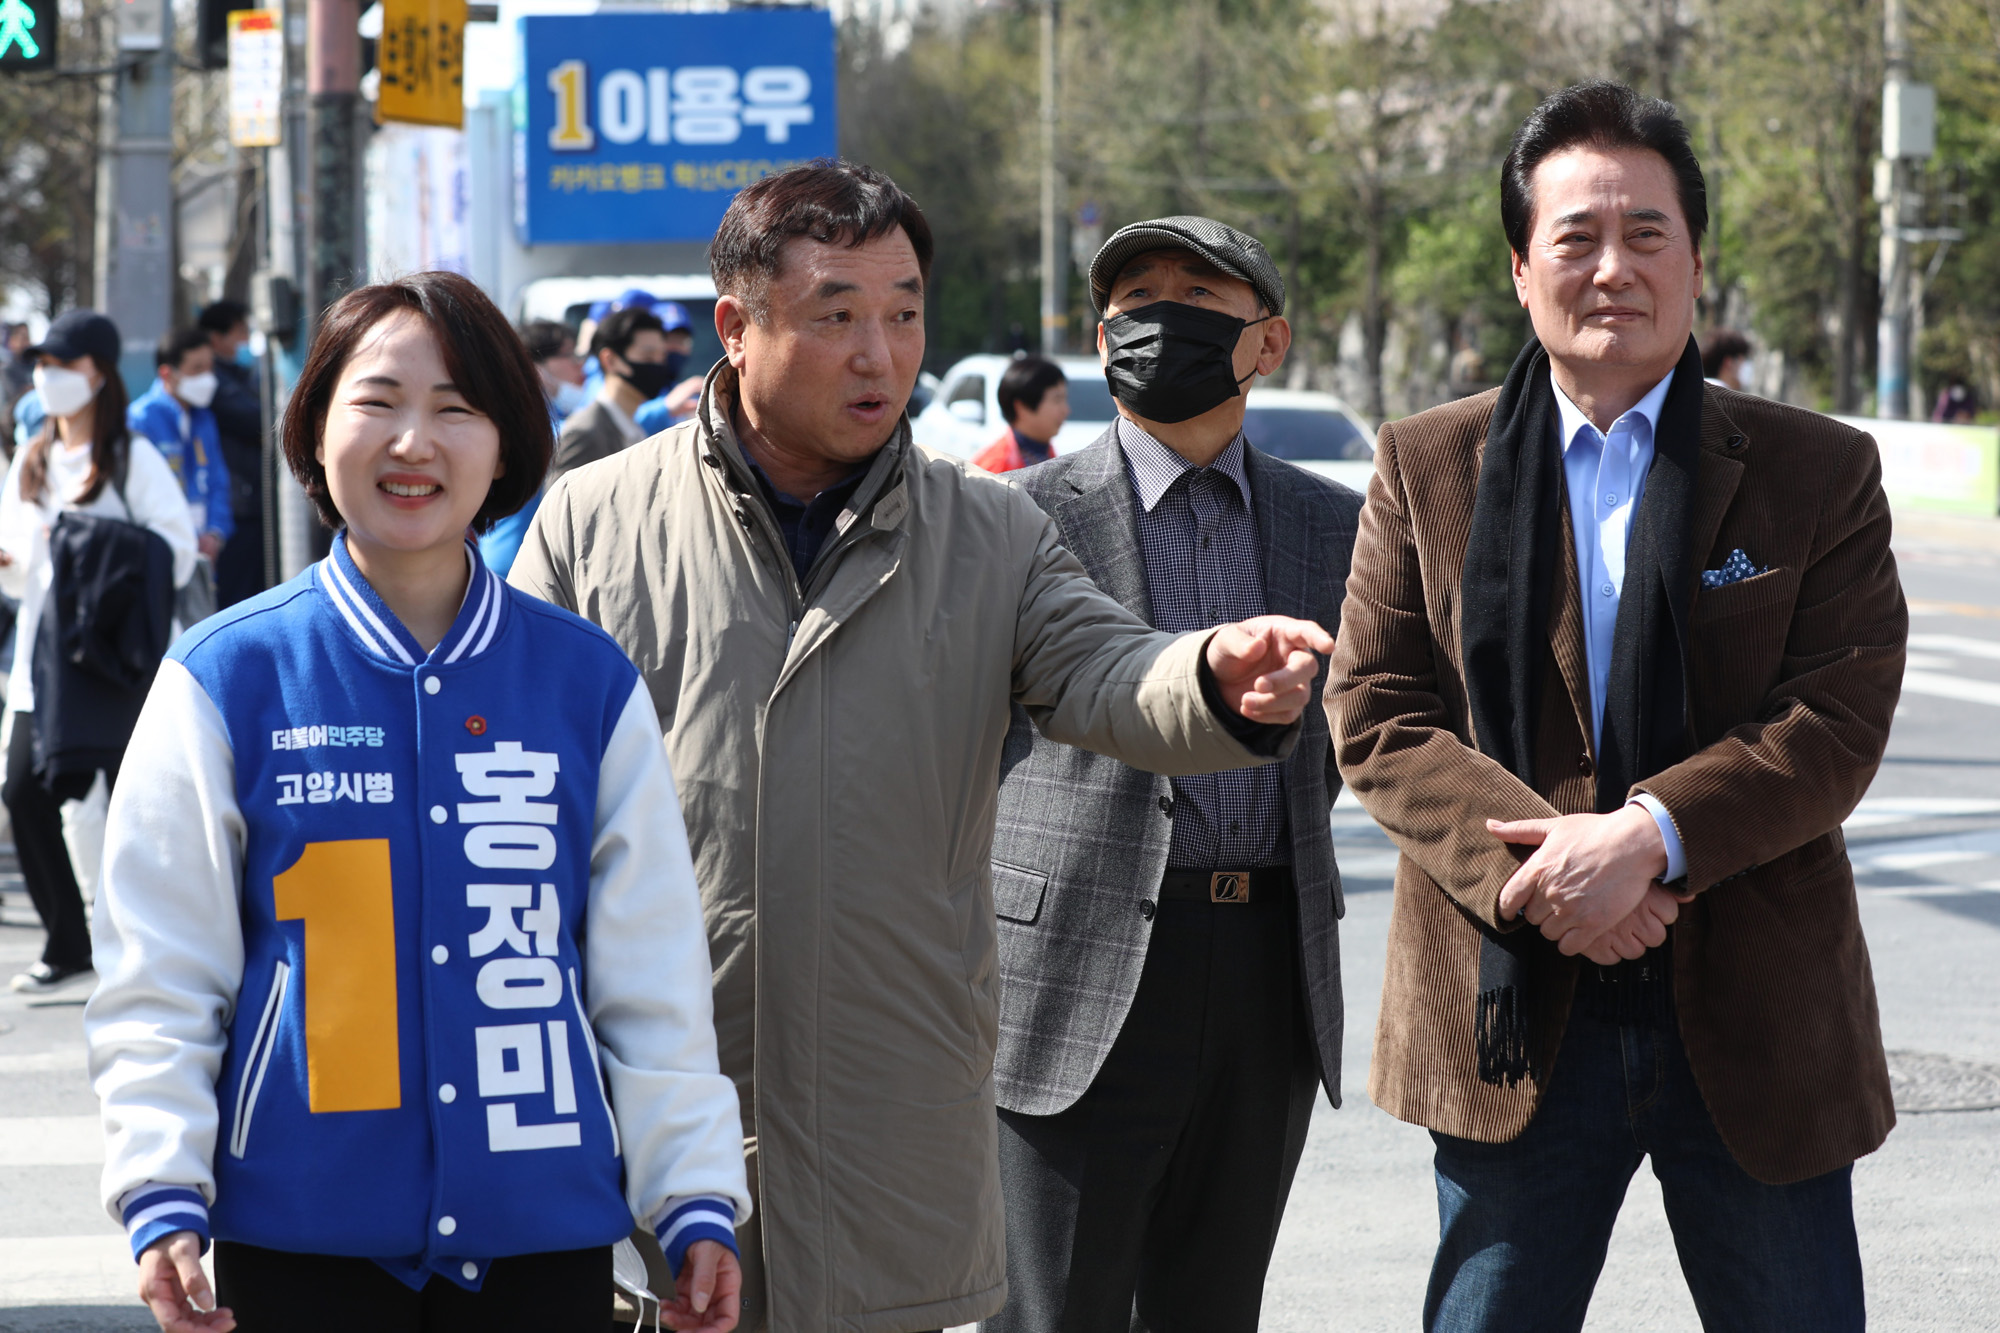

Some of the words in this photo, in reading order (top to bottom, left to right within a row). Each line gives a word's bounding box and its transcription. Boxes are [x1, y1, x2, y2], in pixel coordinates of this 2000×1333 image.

[548, 60, 594, 150] 1
[599, 66, 814, 145] 이용우
[272, 725, 385, 751] 더불어민주당
[276, 771, 394, 806] 고양시병
[273, 838, 401, 1114] 1
[455, 741, 581, 1152] 홍정민
